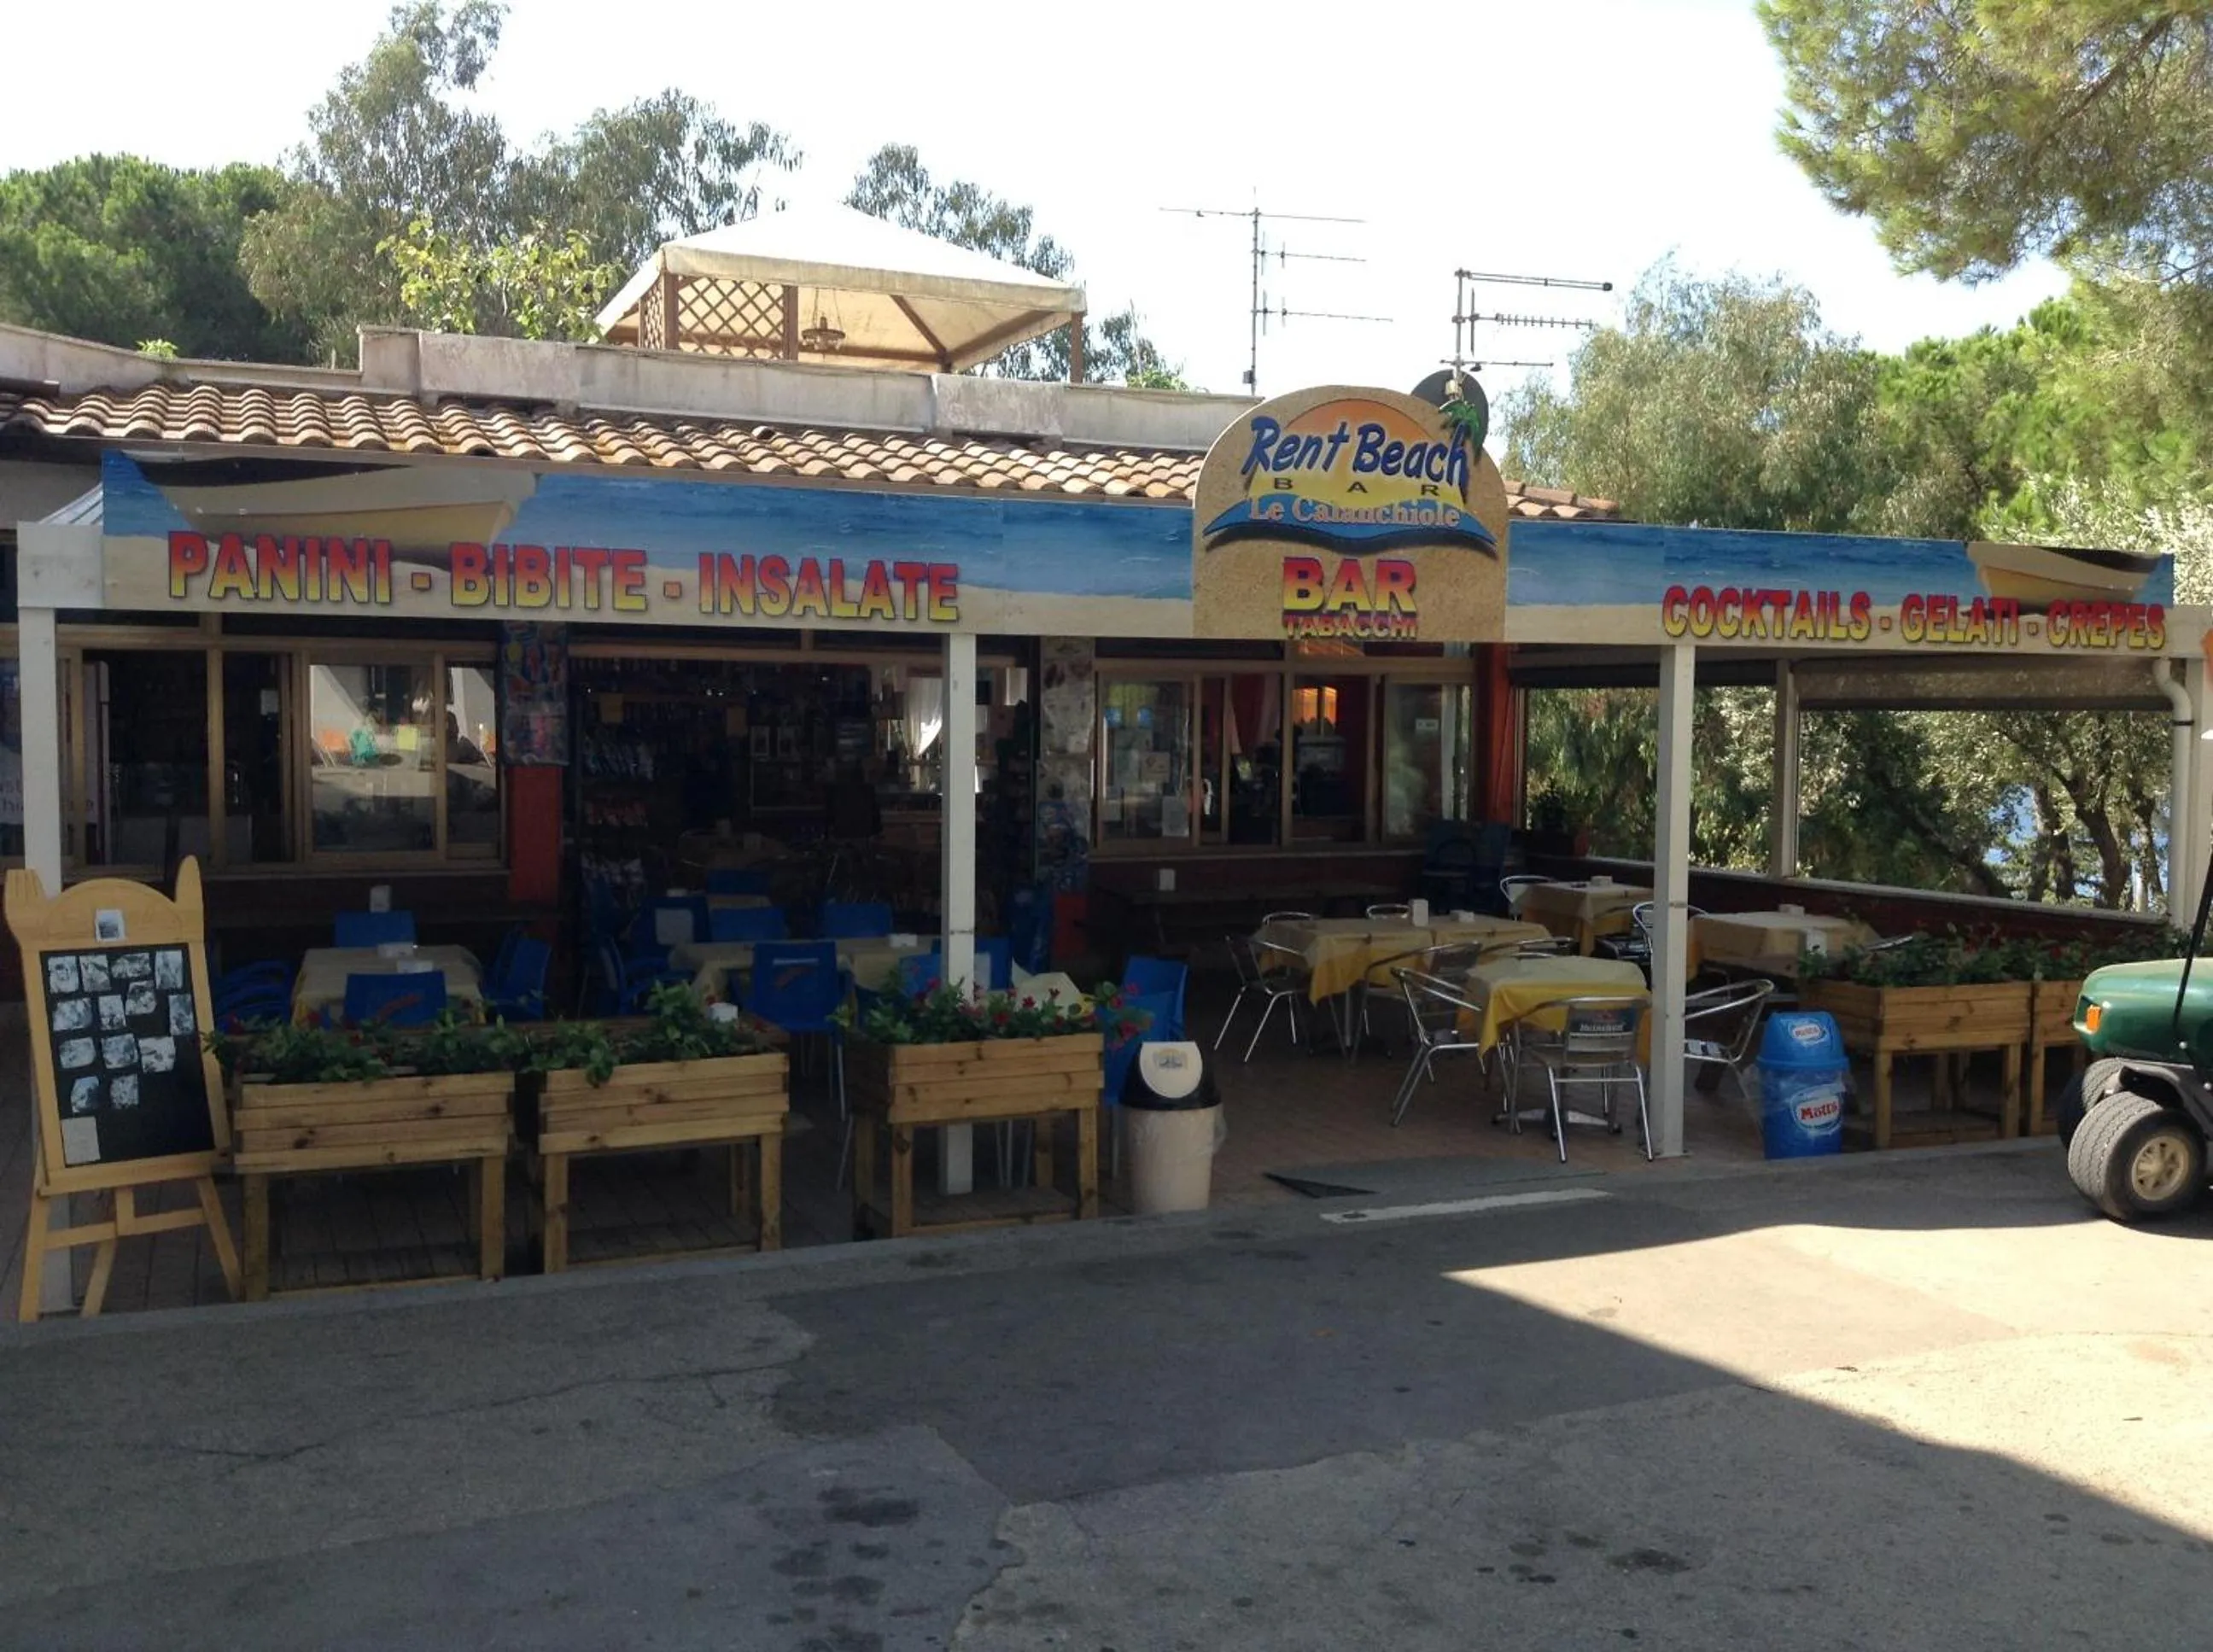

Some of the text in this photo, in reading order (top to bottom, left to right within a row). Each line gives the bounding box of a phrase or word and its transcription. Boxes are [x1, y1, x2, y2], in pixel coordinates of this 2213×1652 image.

[1241, 415, 1469, 504] Rent Beach
[1248, 497, 1285, 522] Le
[167, 529, 960, 622] PANINI BIBITE INSALATE
[1283, 556, 1417, 616] BAR
[1283, 615, 1418, 640] TABACCHI
[1662, 584, 2166, 651] COCKTAILS GELATI CREPES
